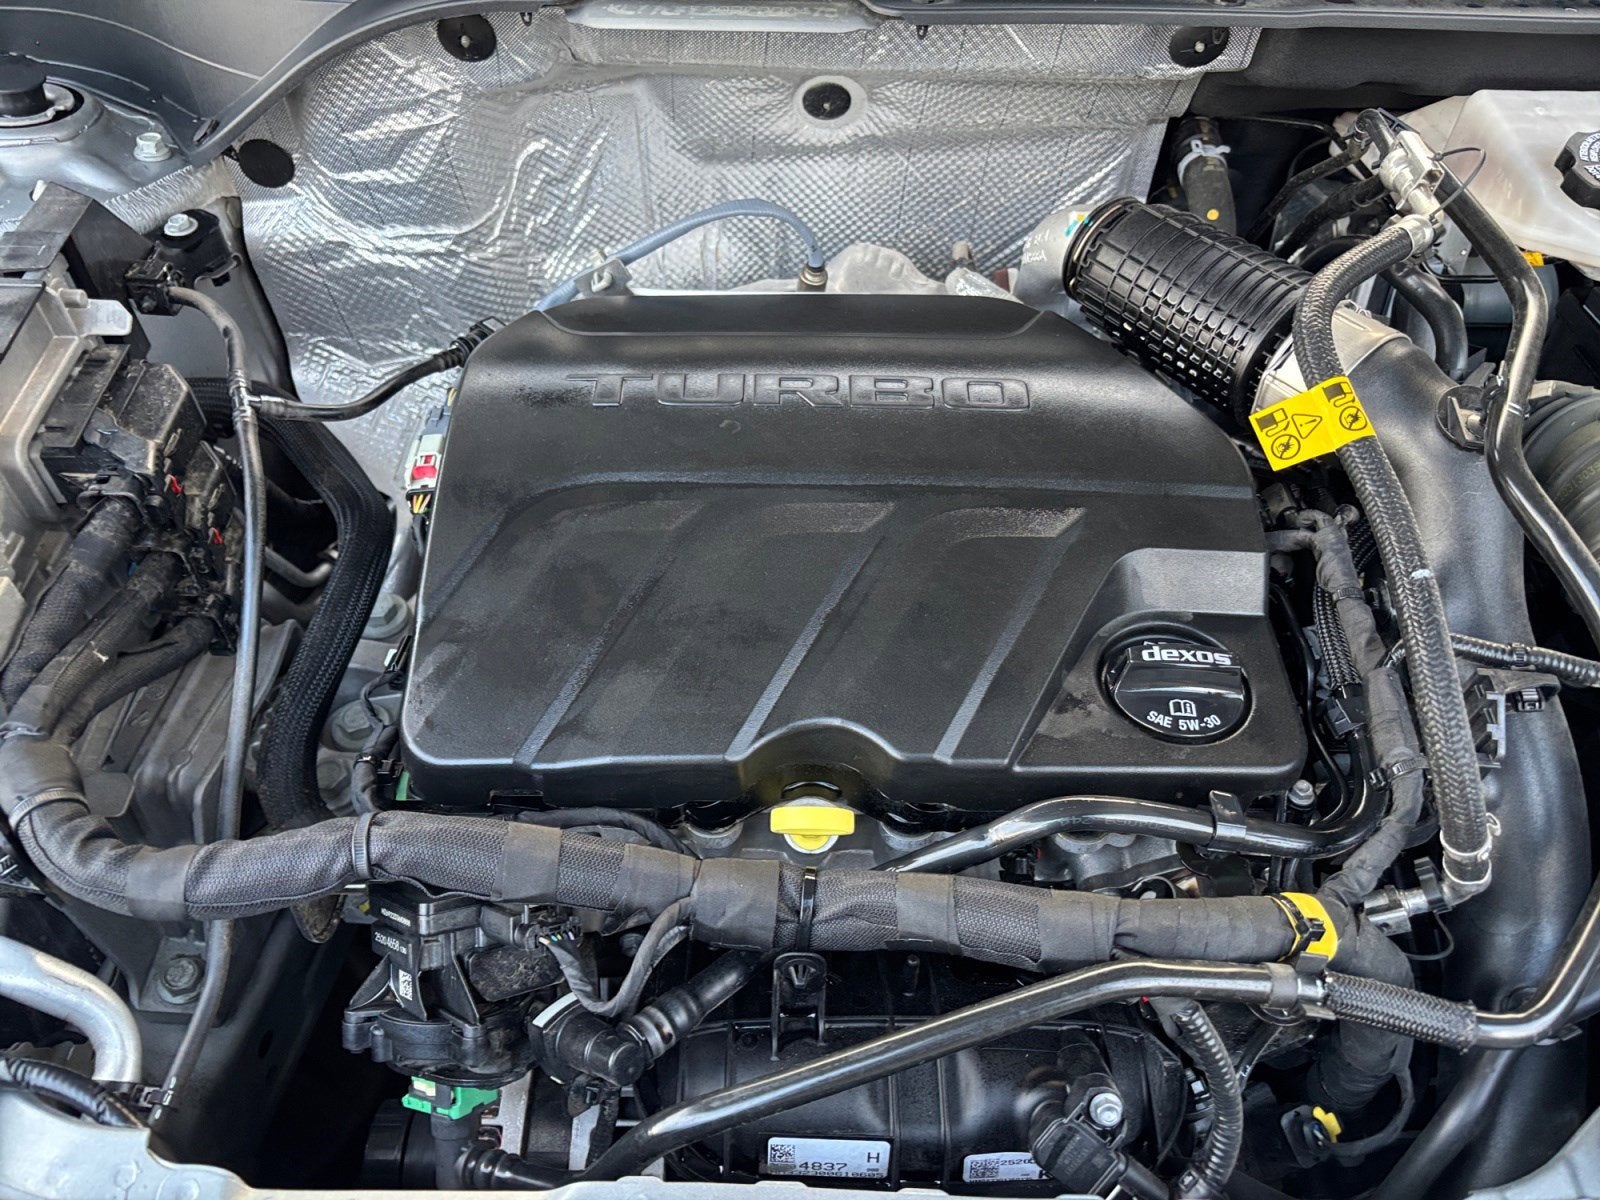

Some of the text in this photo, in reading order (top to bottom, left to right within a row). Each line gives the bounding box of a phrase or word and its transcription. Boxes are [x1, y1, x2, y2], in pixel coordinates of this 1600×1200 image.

[567, 373, 1031, 411] TURBO
[1141, 646, 1232, 666] dexos
[1146, 711, 1222, 731] SAE 5W-30
[798, 1161, 848, 1171] 4837
[866, 1151, 880, 1163] H
